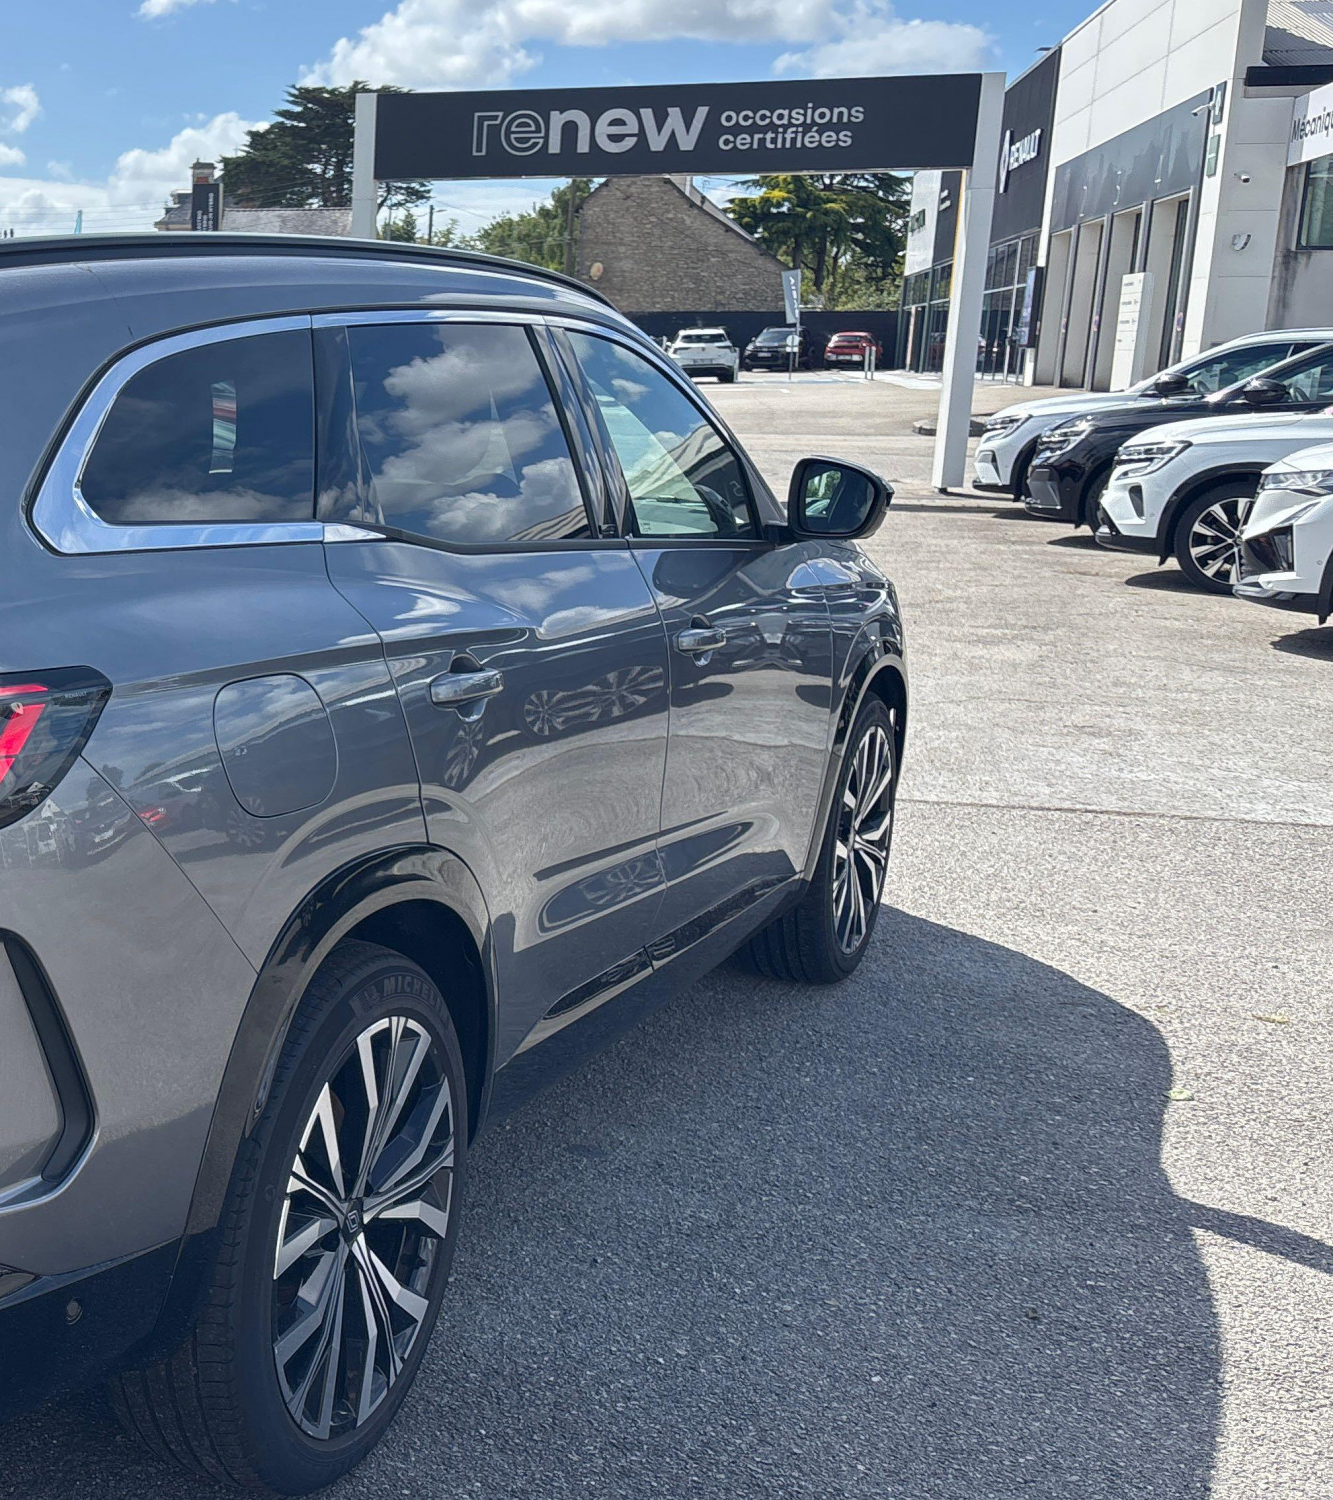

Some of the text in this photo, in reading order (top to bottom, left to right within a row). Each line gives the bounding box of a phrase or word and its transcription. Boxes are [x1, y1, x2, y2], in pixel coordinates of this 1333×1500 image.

[472, 105, 710, 156] renew
[720, 103, 865, 127] occasions
[718, 127, 853, 151] certifiées
[383, 975, 451, 1027] MICHELIN
